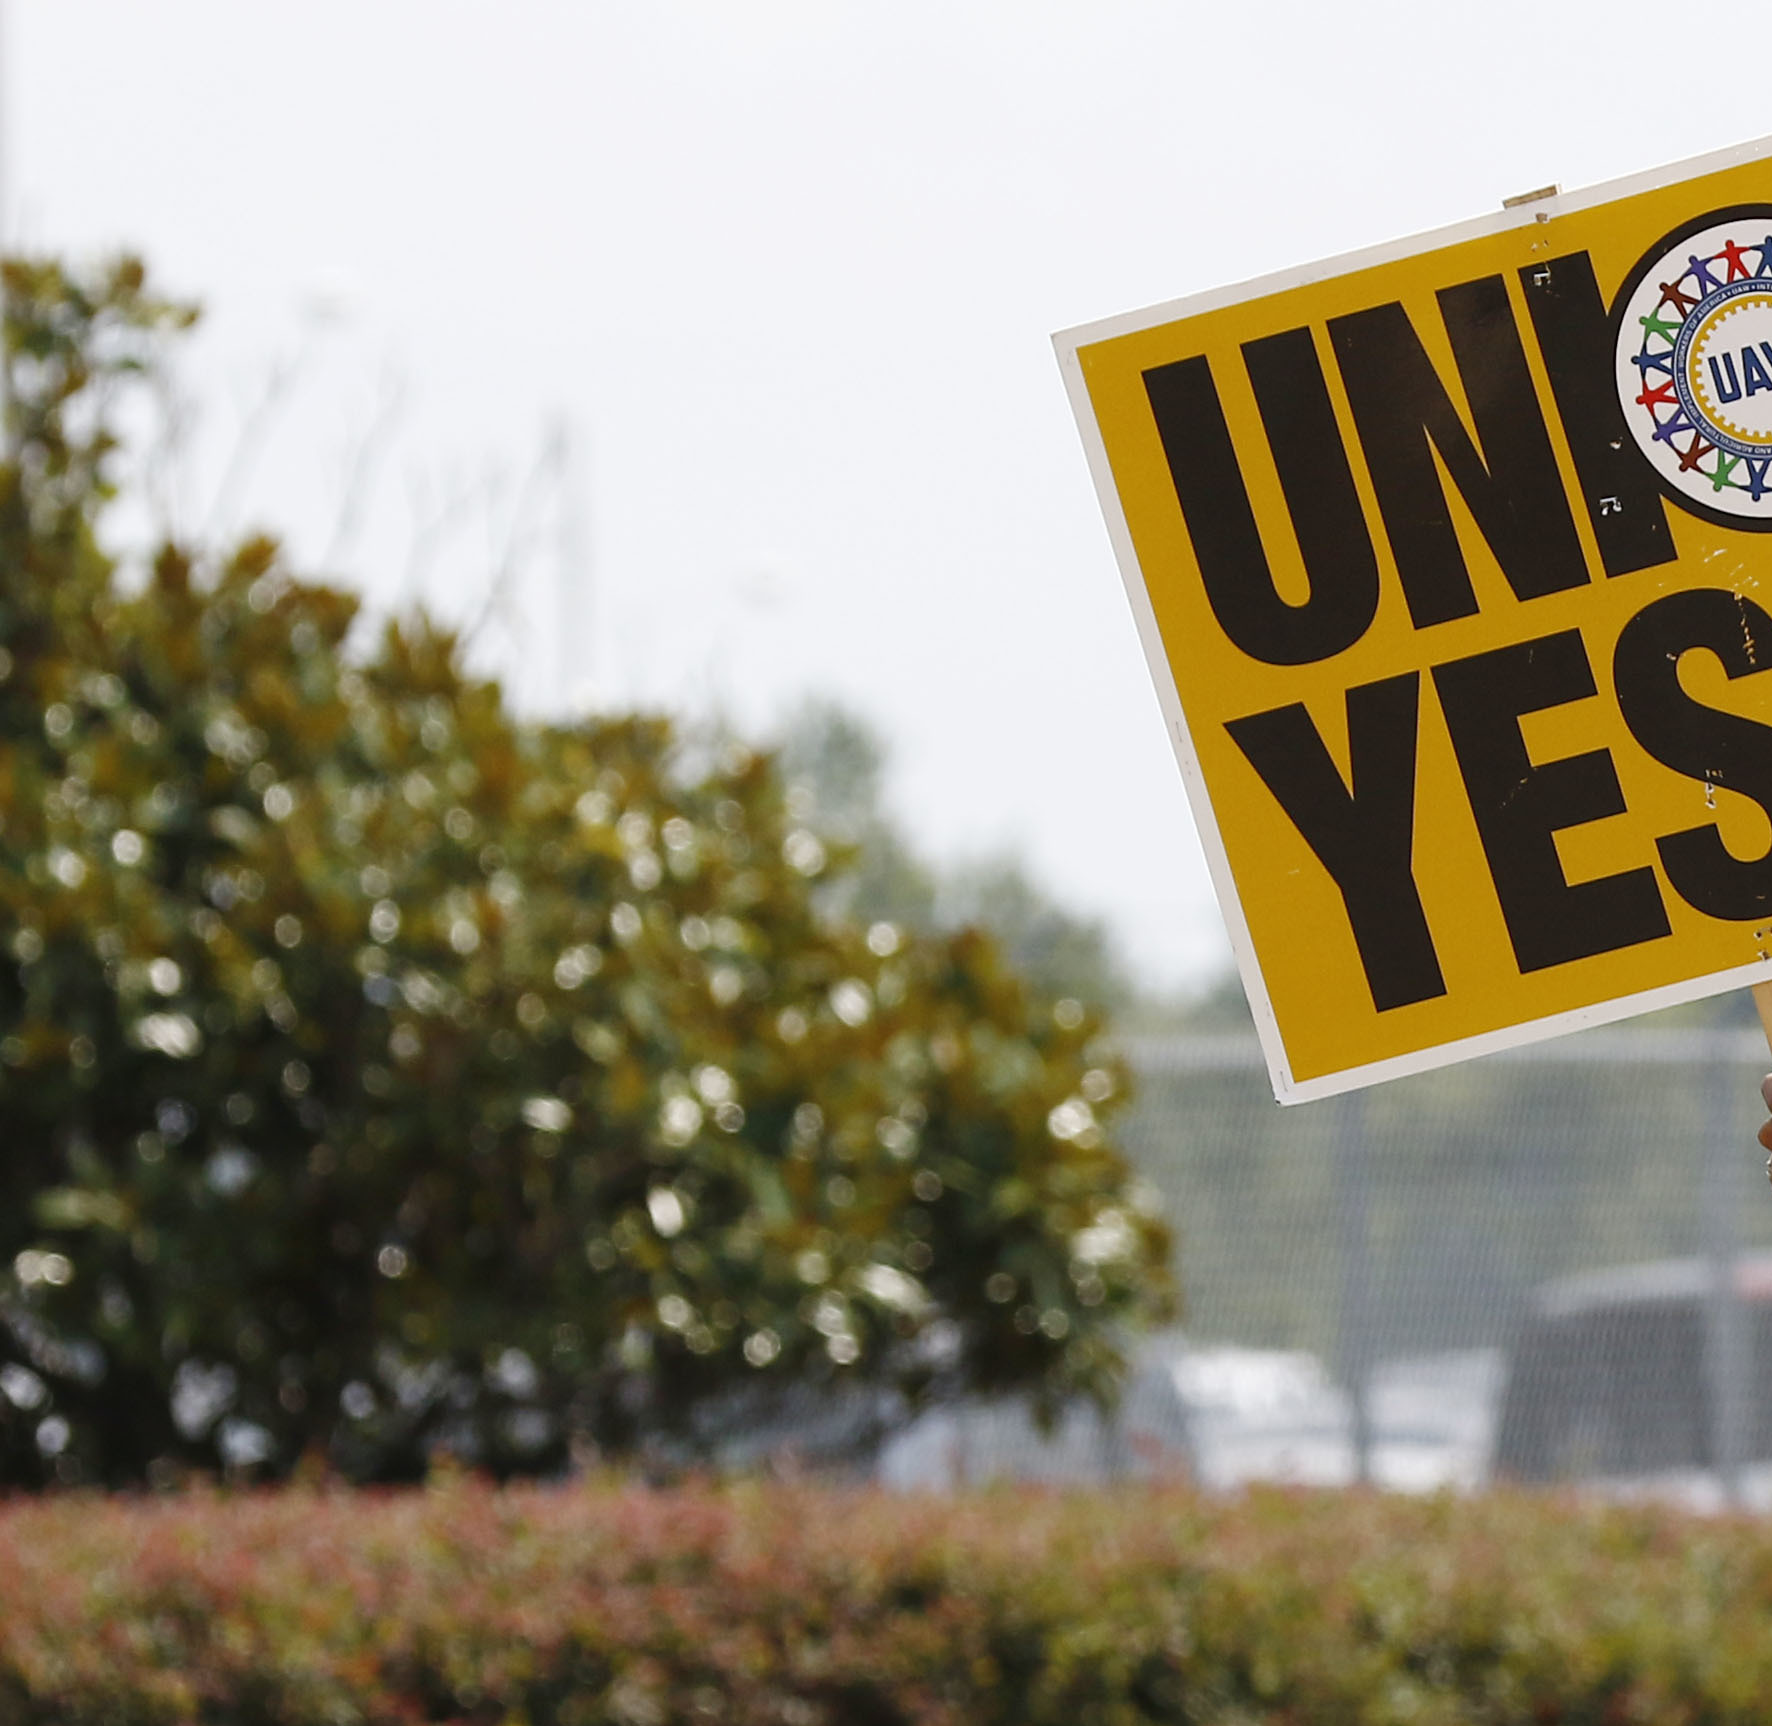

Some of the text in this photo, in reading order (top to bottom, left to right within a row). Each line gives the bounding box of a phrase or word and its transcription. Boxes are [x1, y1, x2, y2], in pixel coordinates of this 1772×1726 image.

[1688, 318, 1699, 330] OF
[1696, 291, 1729, 319] AMERICA
[1732, 284, 1750, 295] UAW
